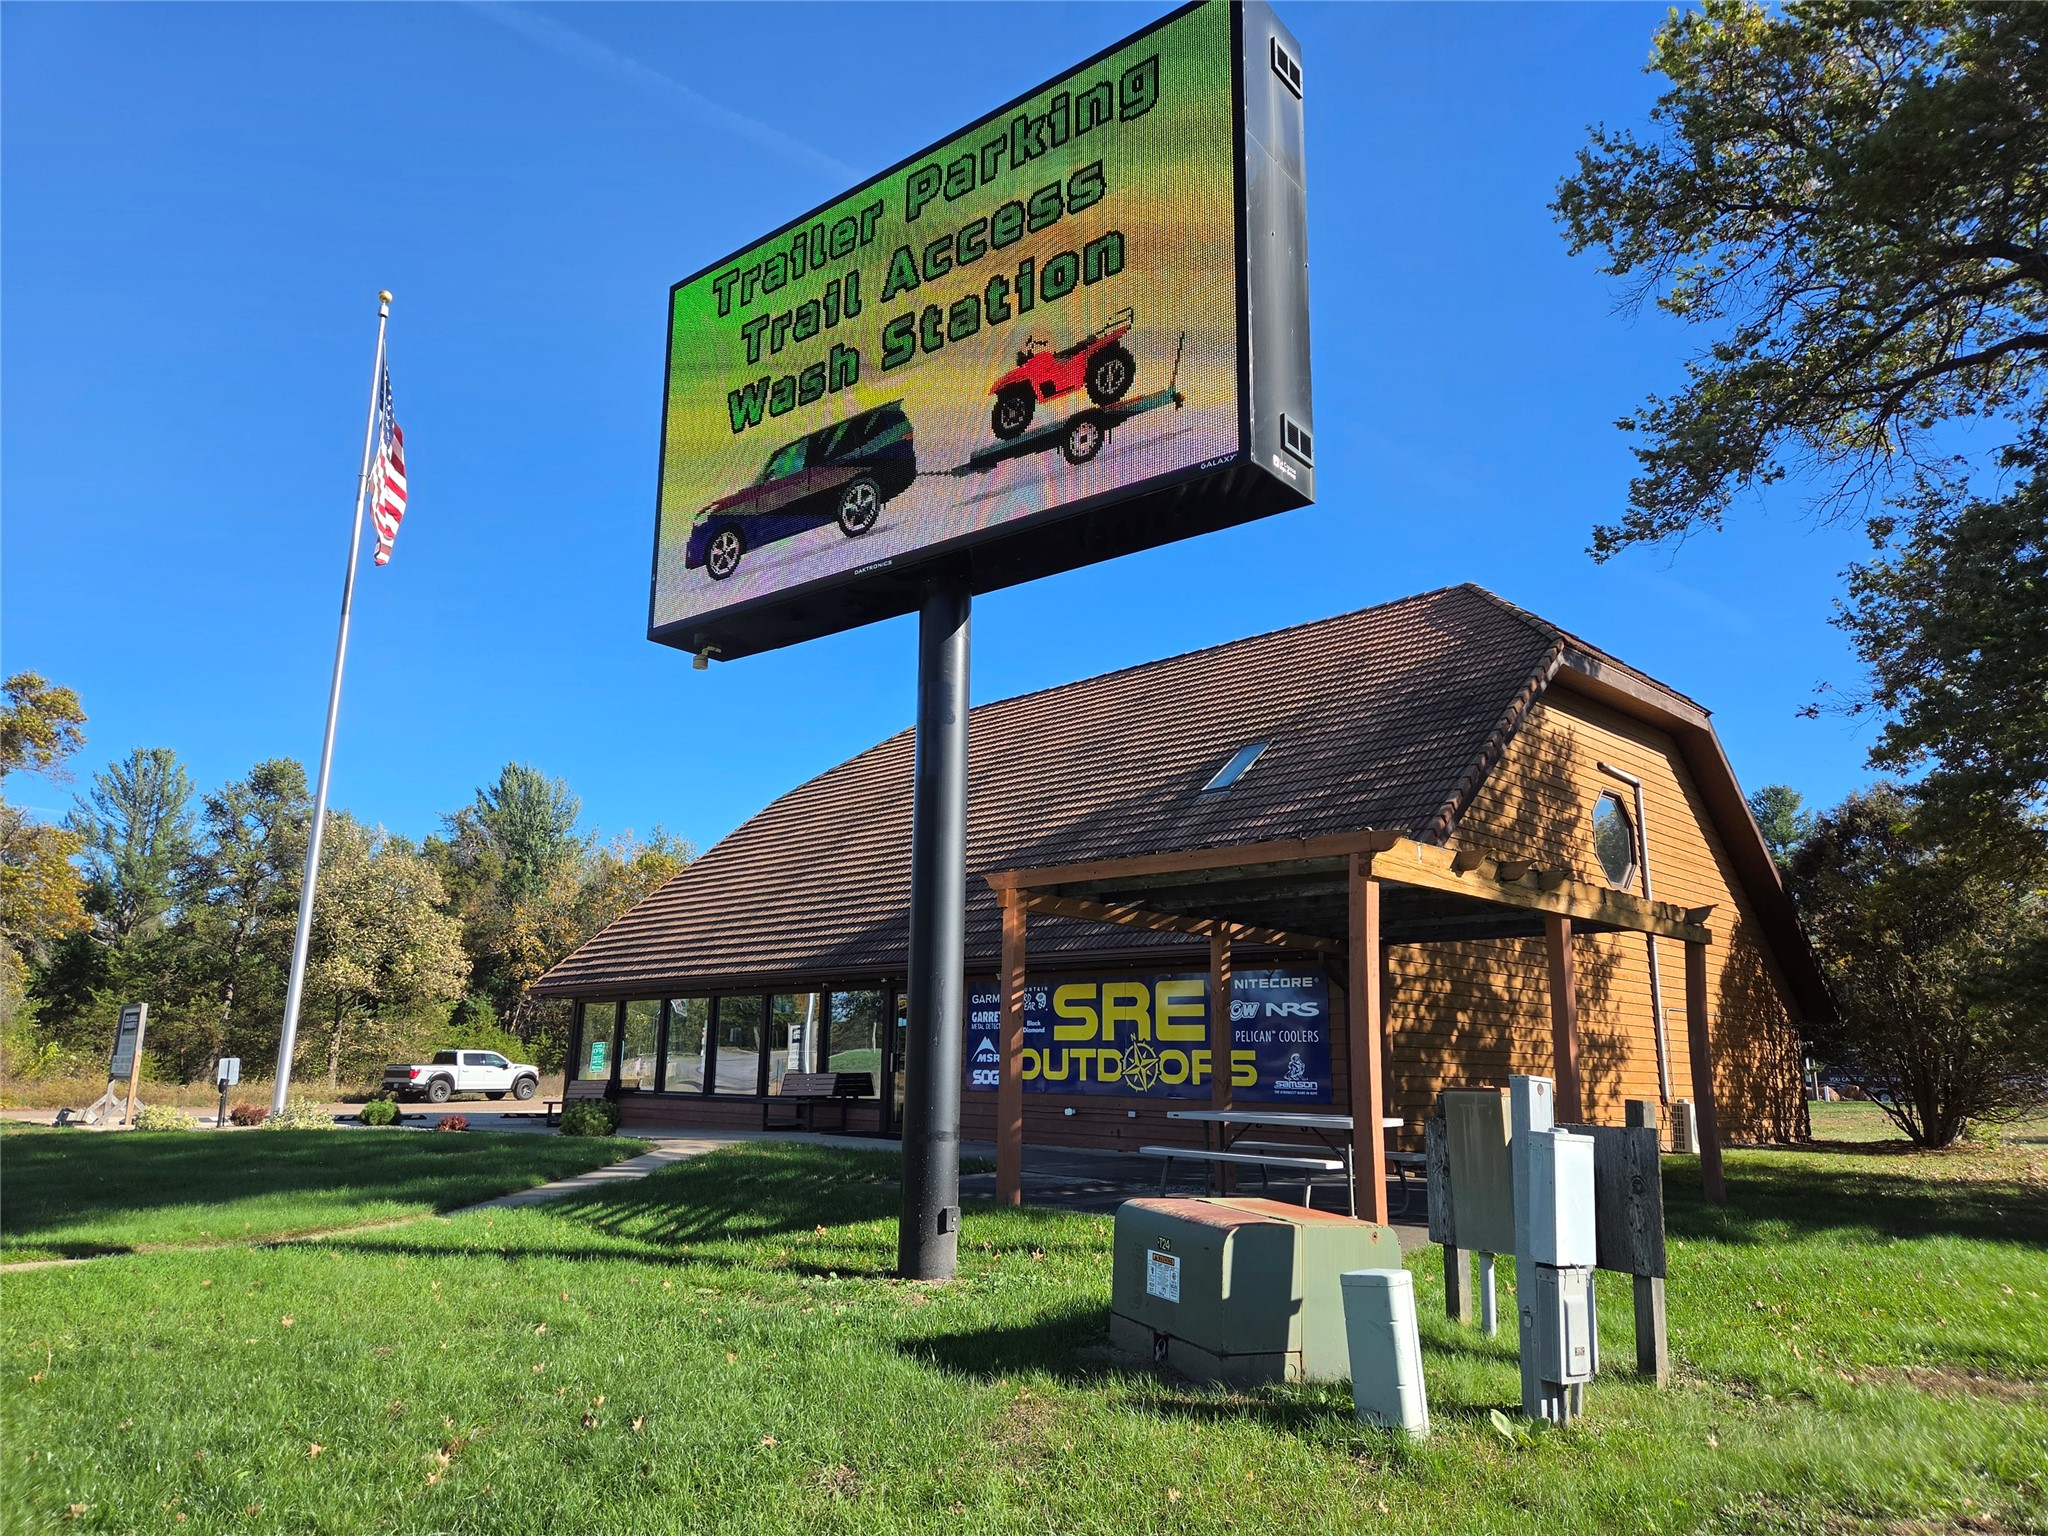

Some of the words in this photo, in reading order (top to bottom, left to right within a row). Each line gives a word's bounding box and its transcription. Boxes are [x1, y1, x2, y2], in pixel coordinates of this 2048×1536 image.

[713, 198, 884, 318] Trailer
[906, 53, 1159, 223] Parking
[741, 269, 862, 365] Trail
[880, 159, 1107, 303] Access
[728, 342, 860, 434] Wash
[881, 230, 1125, 371] Station
[1200, 453, 1236, 470] GALAXY
[1234, 977, 1313, 989] NITECORE
[972, 993, 1000, 1004] GARM
[1053, 979, 1205, 1041] SRE
[1265, 1002, 1320, 1017] NRS
[1279, 1030, 1319, 1042] COOLERS
[977, 1053, 1000, 1062] MSR
